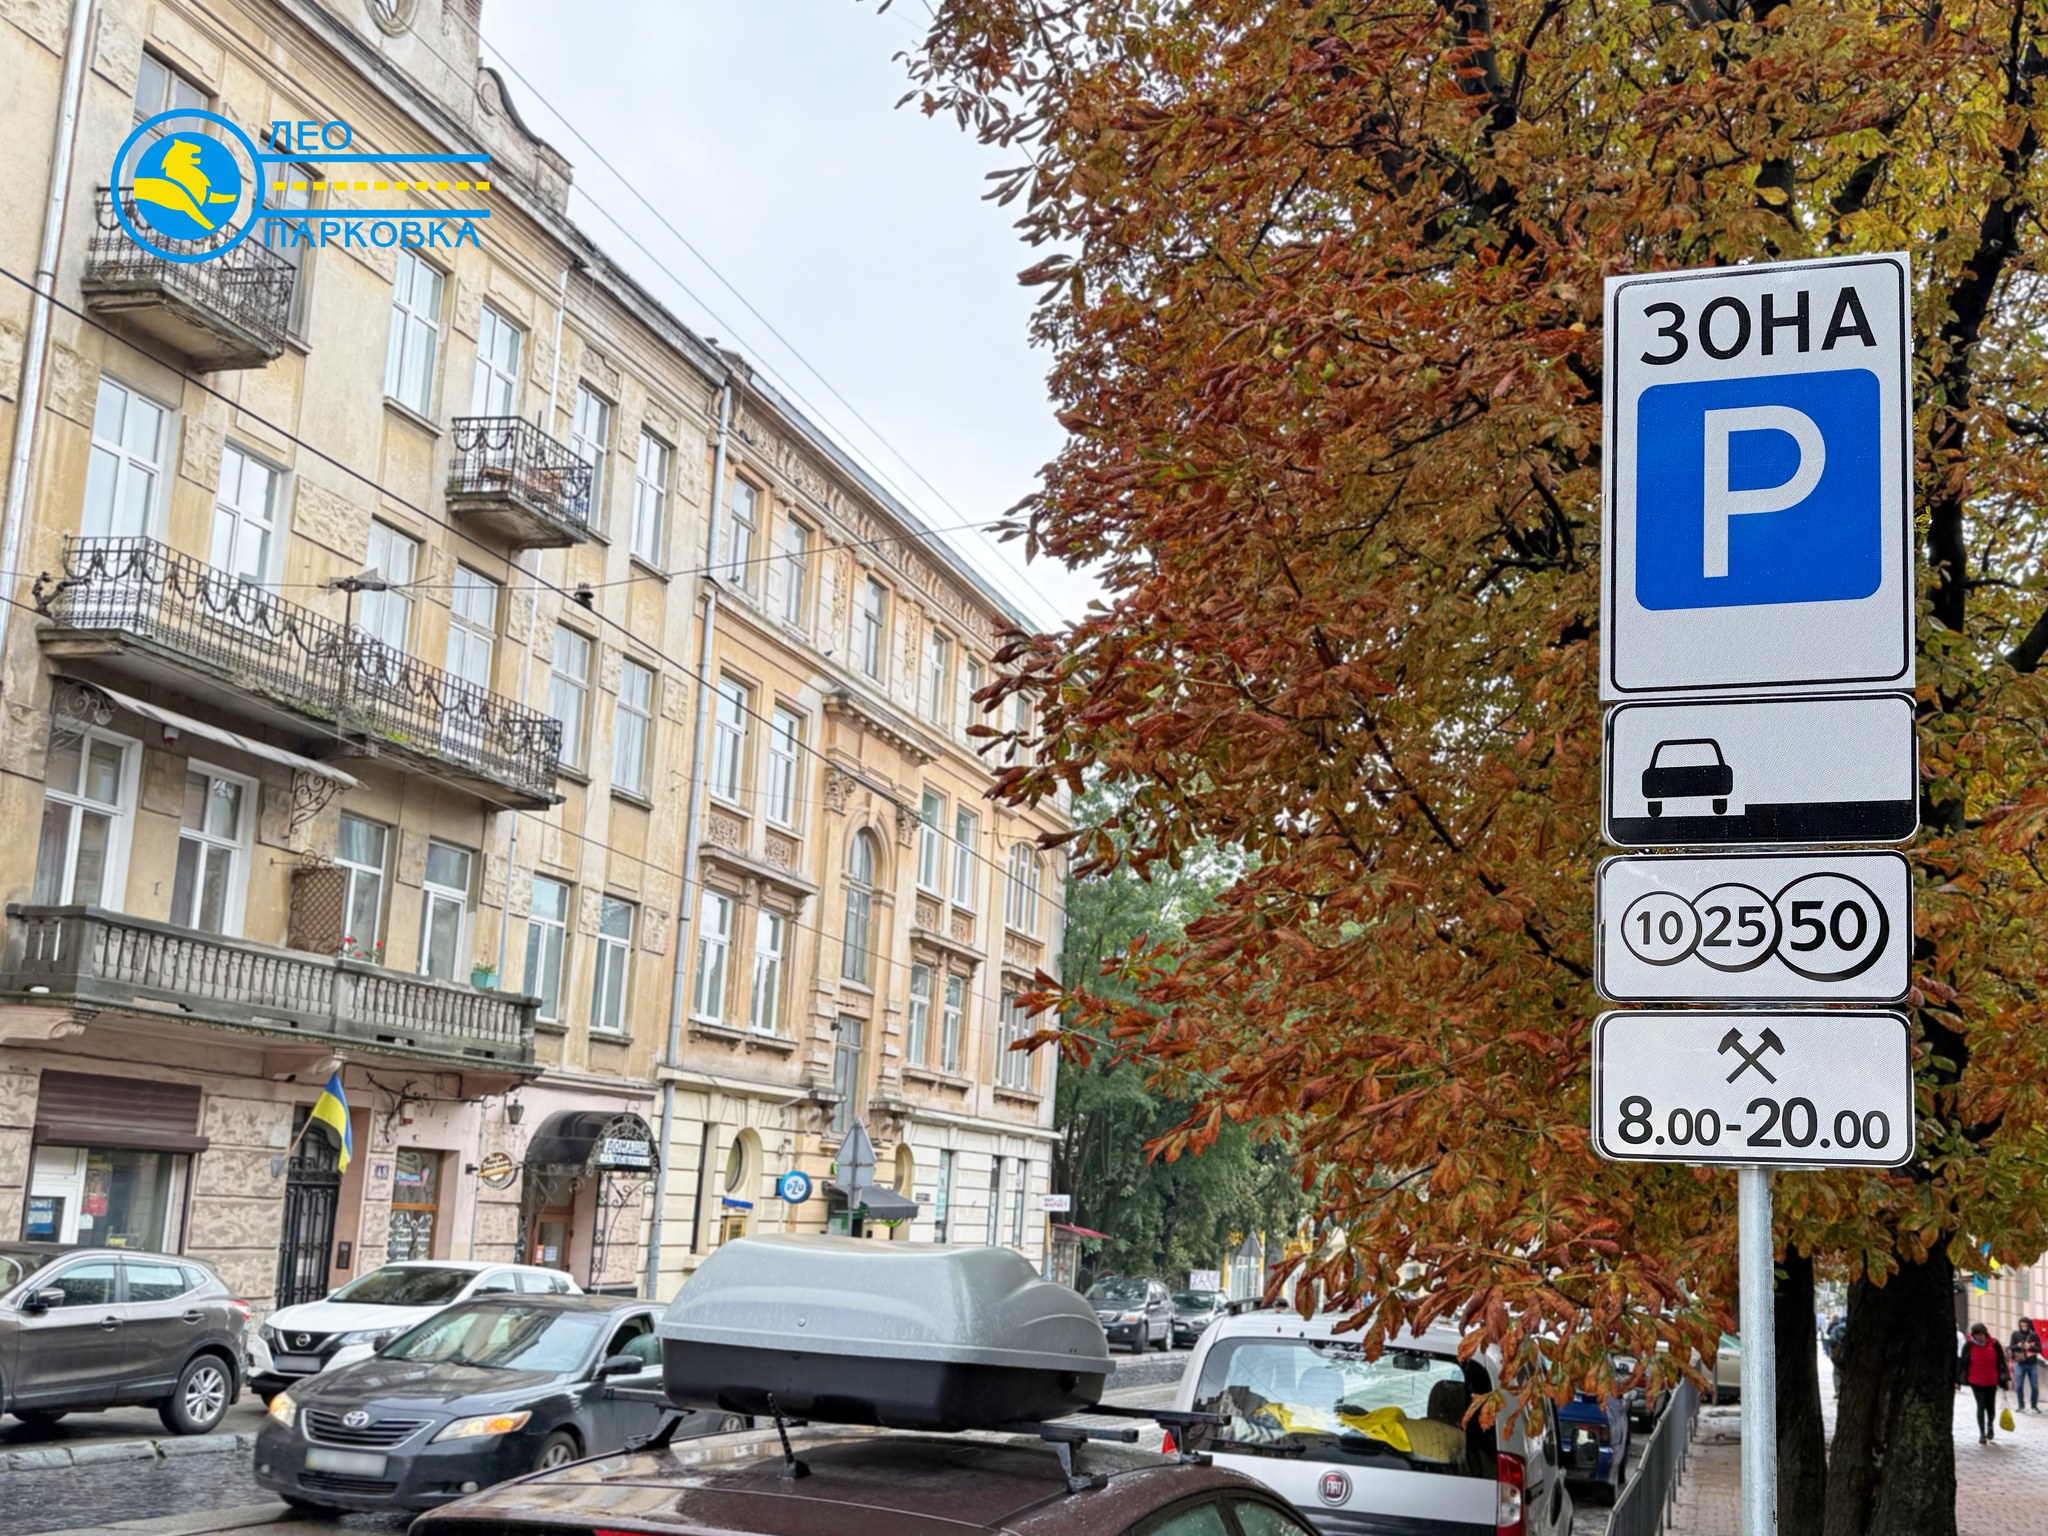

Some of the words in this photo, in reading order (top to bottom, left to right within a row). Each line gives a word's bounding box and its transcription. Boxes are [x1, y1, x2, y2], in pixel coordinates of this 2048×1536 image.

[1640, 286, 1877, 365] ЗОНА
[1703, 405, 1826, 578] P
[1636, 910, 1684, 945] 10
[1702, 905, 1767, 948] 25
[1790, 900, 1868, 952] 50
[1618, 1095, 1890, 1149] 8.00-20.00
[786, 1180, 805, 1195] PZU
[1326, 1480, 1343, 1495] FIAT
